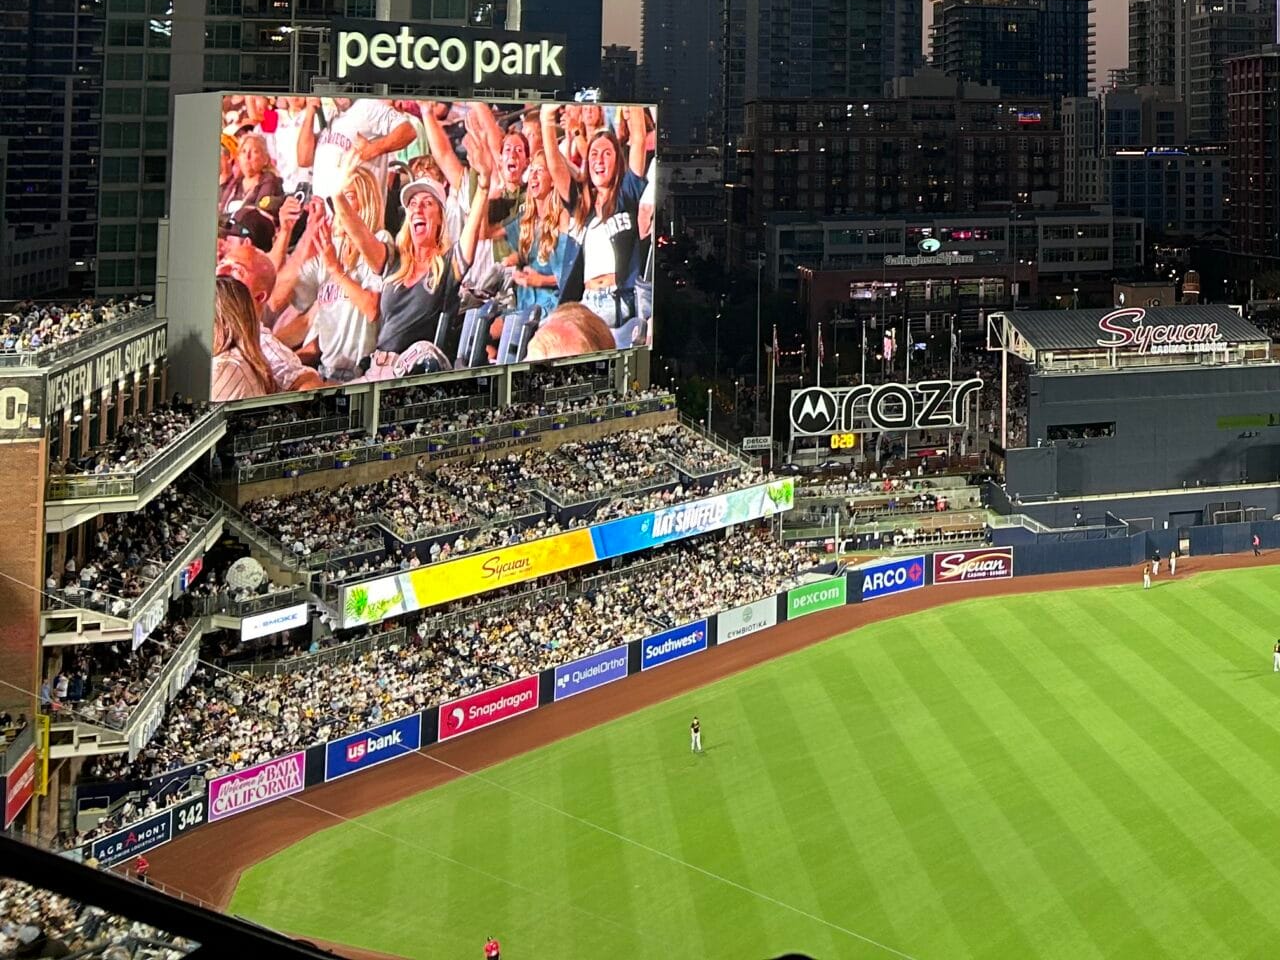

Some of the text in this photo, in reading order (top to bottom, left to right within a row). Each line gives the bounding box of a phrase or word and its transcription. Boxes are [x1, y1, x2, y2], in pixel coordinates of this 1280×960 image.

[336, 26, 564, 83] petco park
[884, 252, 974, 266] Gallagher Square
[1097, 307, 1223, 355] Sycuan
[48, 328, 168, 415] WESTERN METAL SUPPLY CO.
[841, 377, 984, 433] razr
[430, 447, 472, 461] ESTRELLA
[507, 435, 542, 448] LANDING
[830, 433, 855, 449] 0:28
[651, 503, 725, 539] HAT SHUFFLE
[481, 556, 530, 580] Sycuan
[862, 567, 907, 593] ARCO
[938, 553, 1005, 580] Sycuan
[261, 612, 299, 627] SMOKE
[727, 620, 768, 638] CYMBIOTIKA
[646, 632, 695, 659] Southwest
[572, 658, 625, 683] QuidelOrtho
[469, 687, 532, 719] Snapdragon
[348, 729, 402, 759] us bank
[266, 758, 298, 782] BAJA
[213, 773, 300, 812] CALIFORNIA
[177, 801, 204, 829] 342
[98, 822, 167, 858] AGRAMONT
